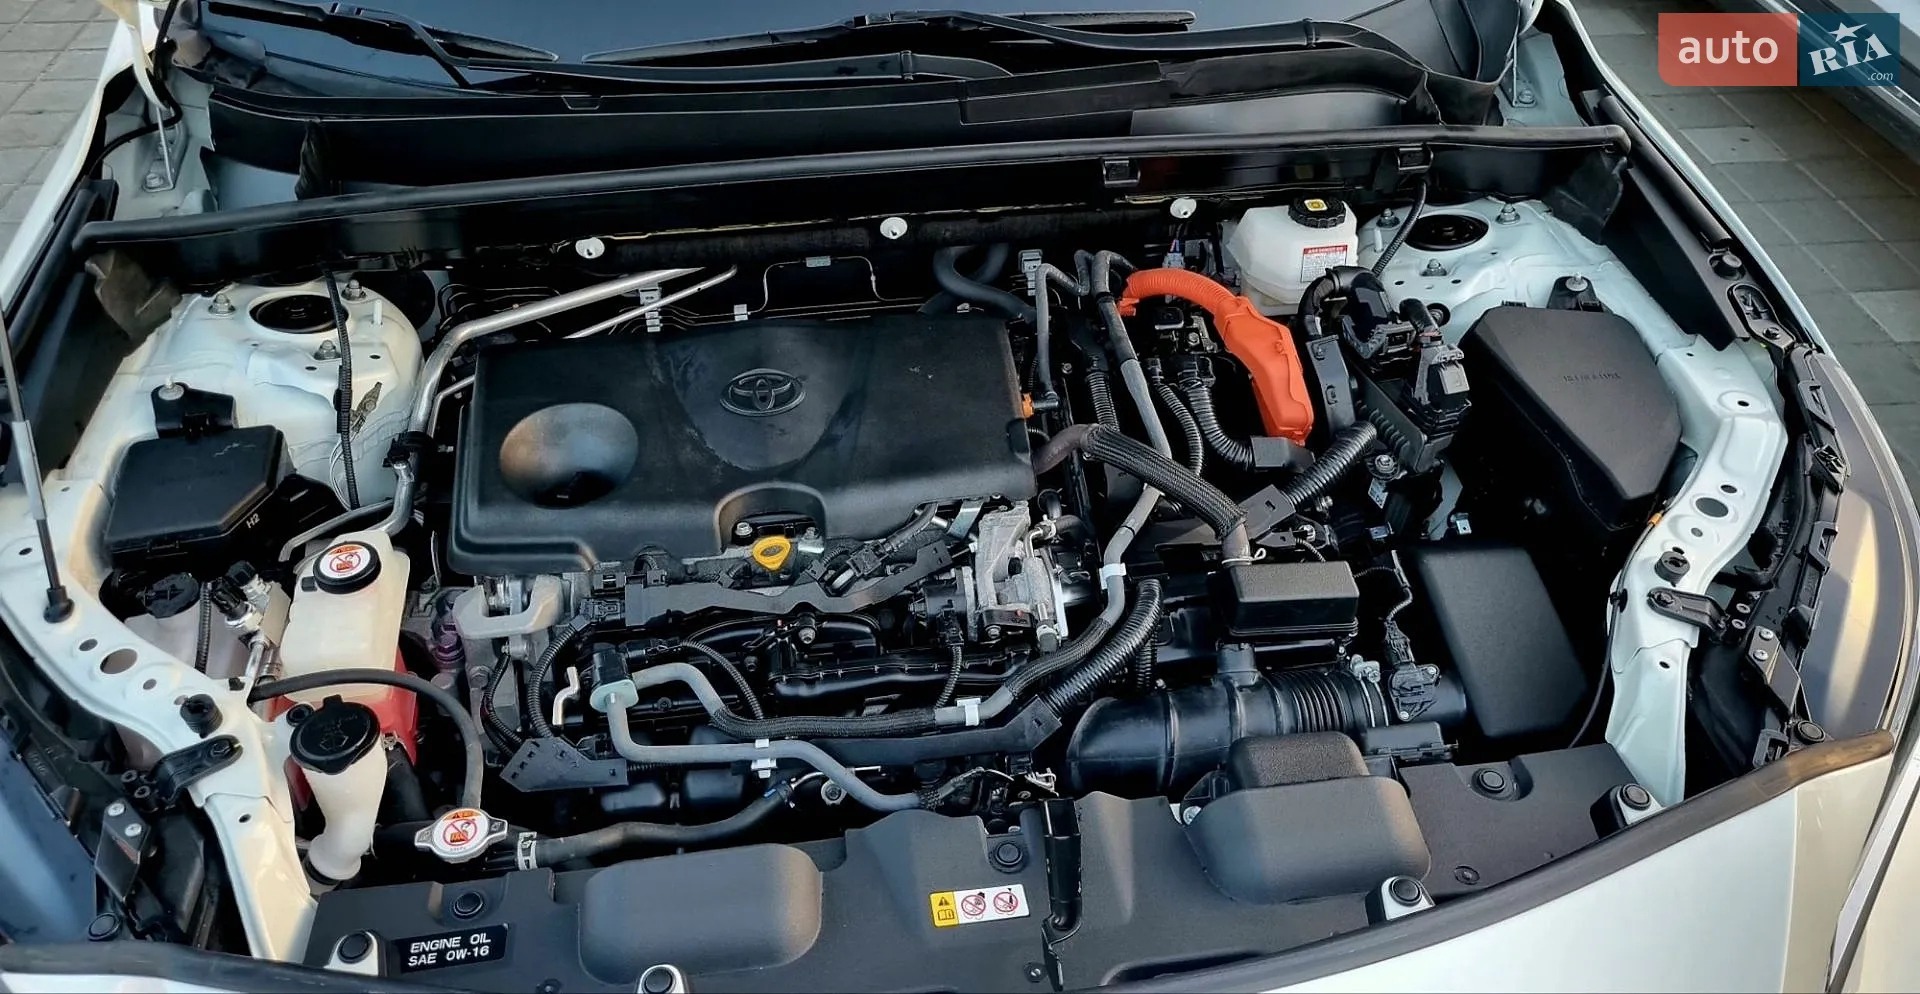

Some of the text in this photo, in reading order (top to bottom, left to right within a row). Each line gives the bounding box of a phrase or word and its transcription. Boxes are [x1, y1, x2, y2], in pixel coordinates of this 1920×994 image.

[246, 513, 260, 528] H2
[410, 932, 491, 954] ENGINE OIL
[408, 952, 437, 967] SAE
